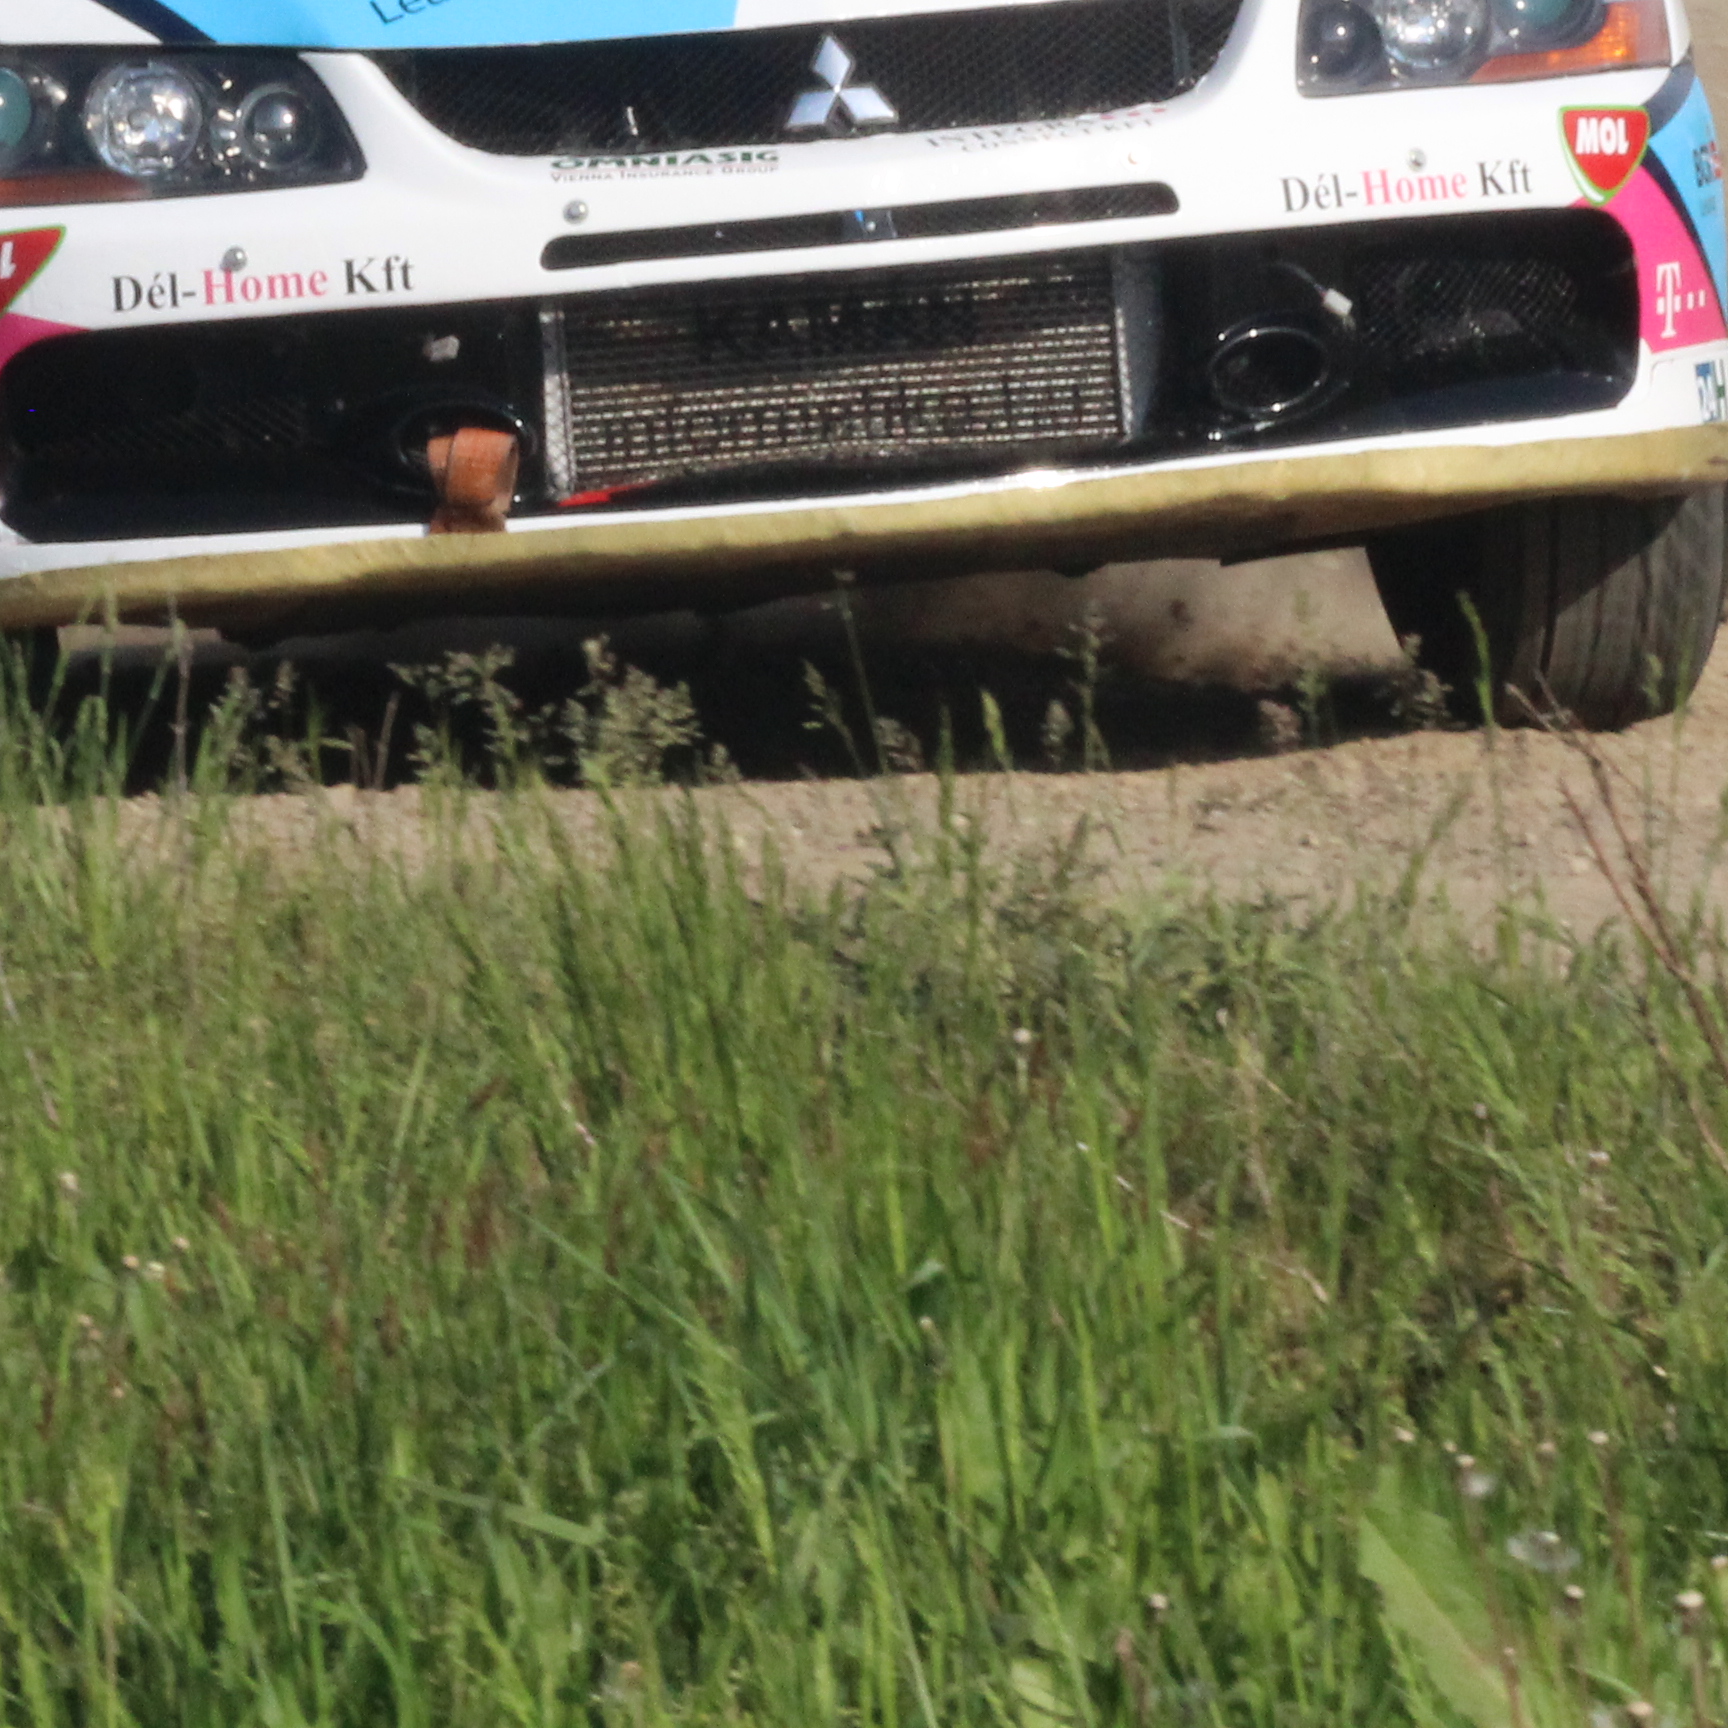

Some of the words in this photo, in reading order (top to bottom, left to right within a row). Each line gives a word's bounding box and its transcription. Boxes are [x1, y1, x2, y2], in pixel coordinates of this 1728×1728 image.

[1575, 116, 1629, 156] MOL
[551, 149, 780, 170] OMNIASIG
[1477, 158, 1534, 197] Kft
[343, 254, 416, 296] Kft
